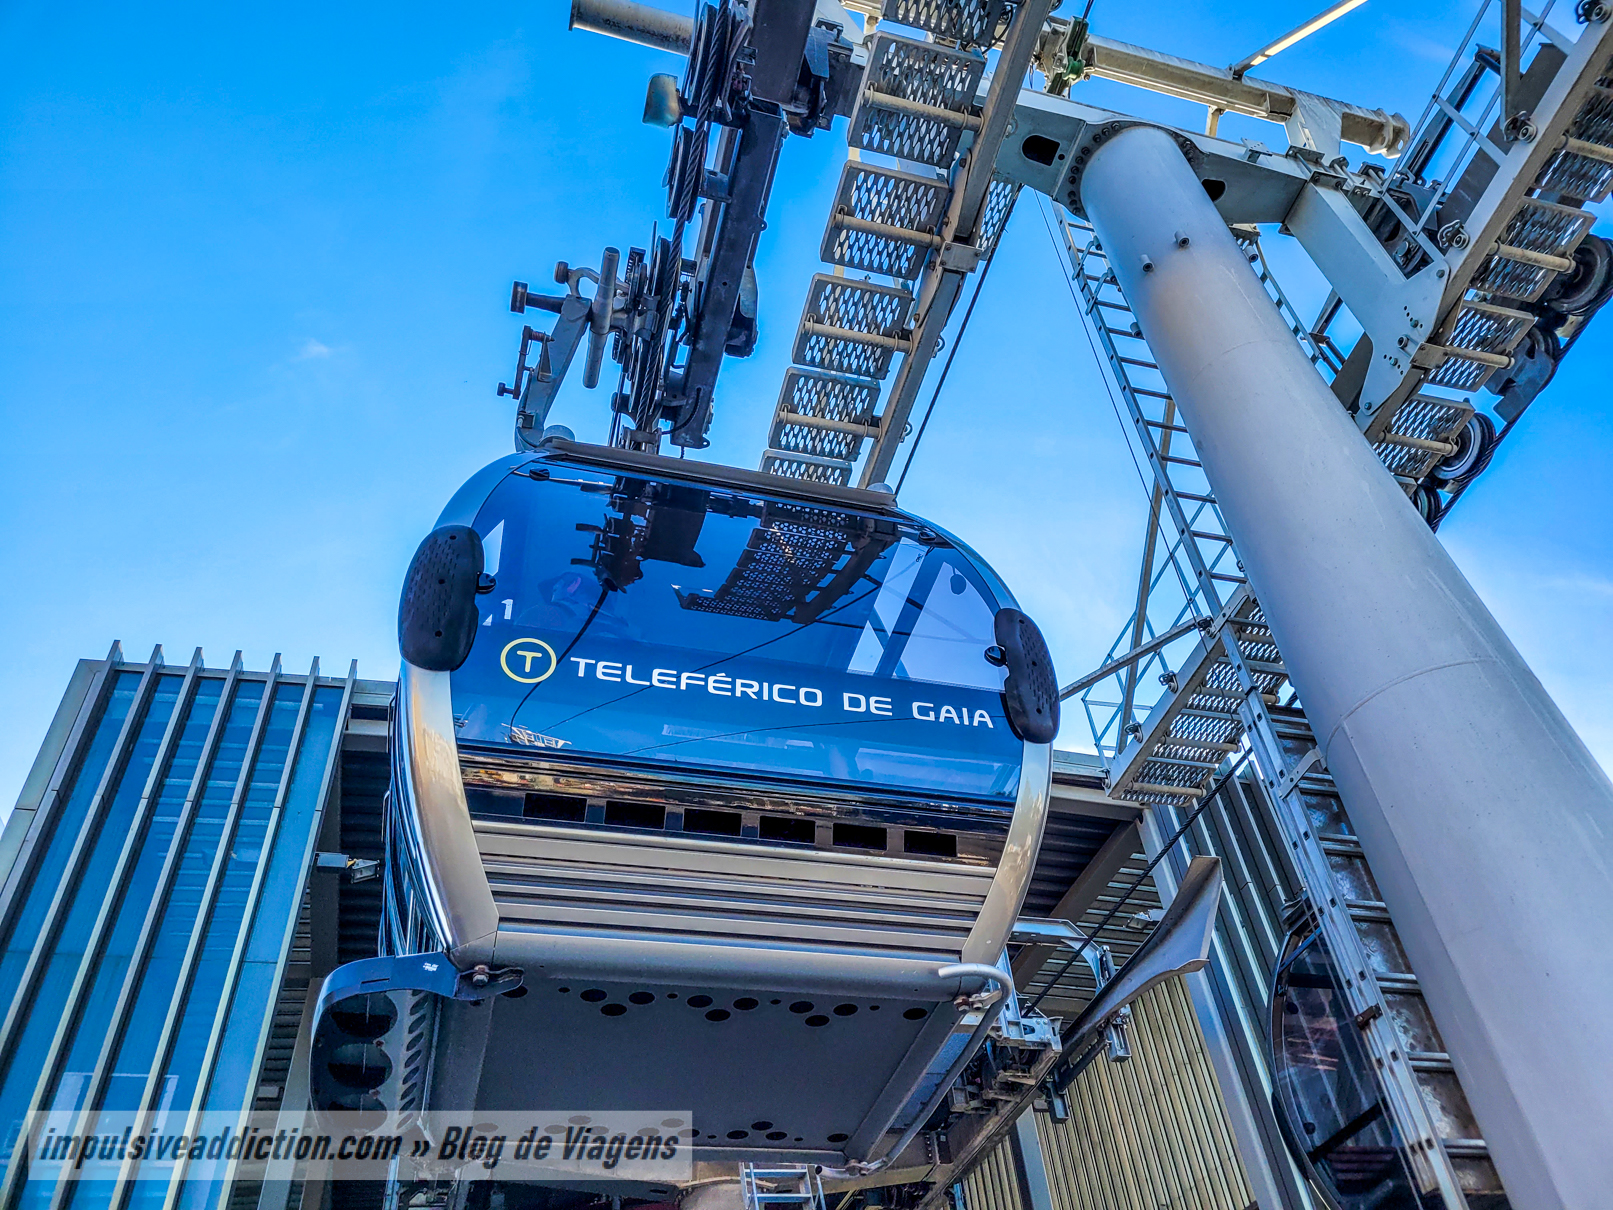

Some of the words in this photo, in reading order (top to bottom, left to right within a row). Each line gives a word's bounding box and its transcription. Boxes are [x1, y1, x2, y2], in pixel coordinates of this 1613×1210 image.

[570, 656, 823, 707] TELEFÉRICO
[843, 692, 893, 716] DE
[912, 701, 994, 728] GAIA
